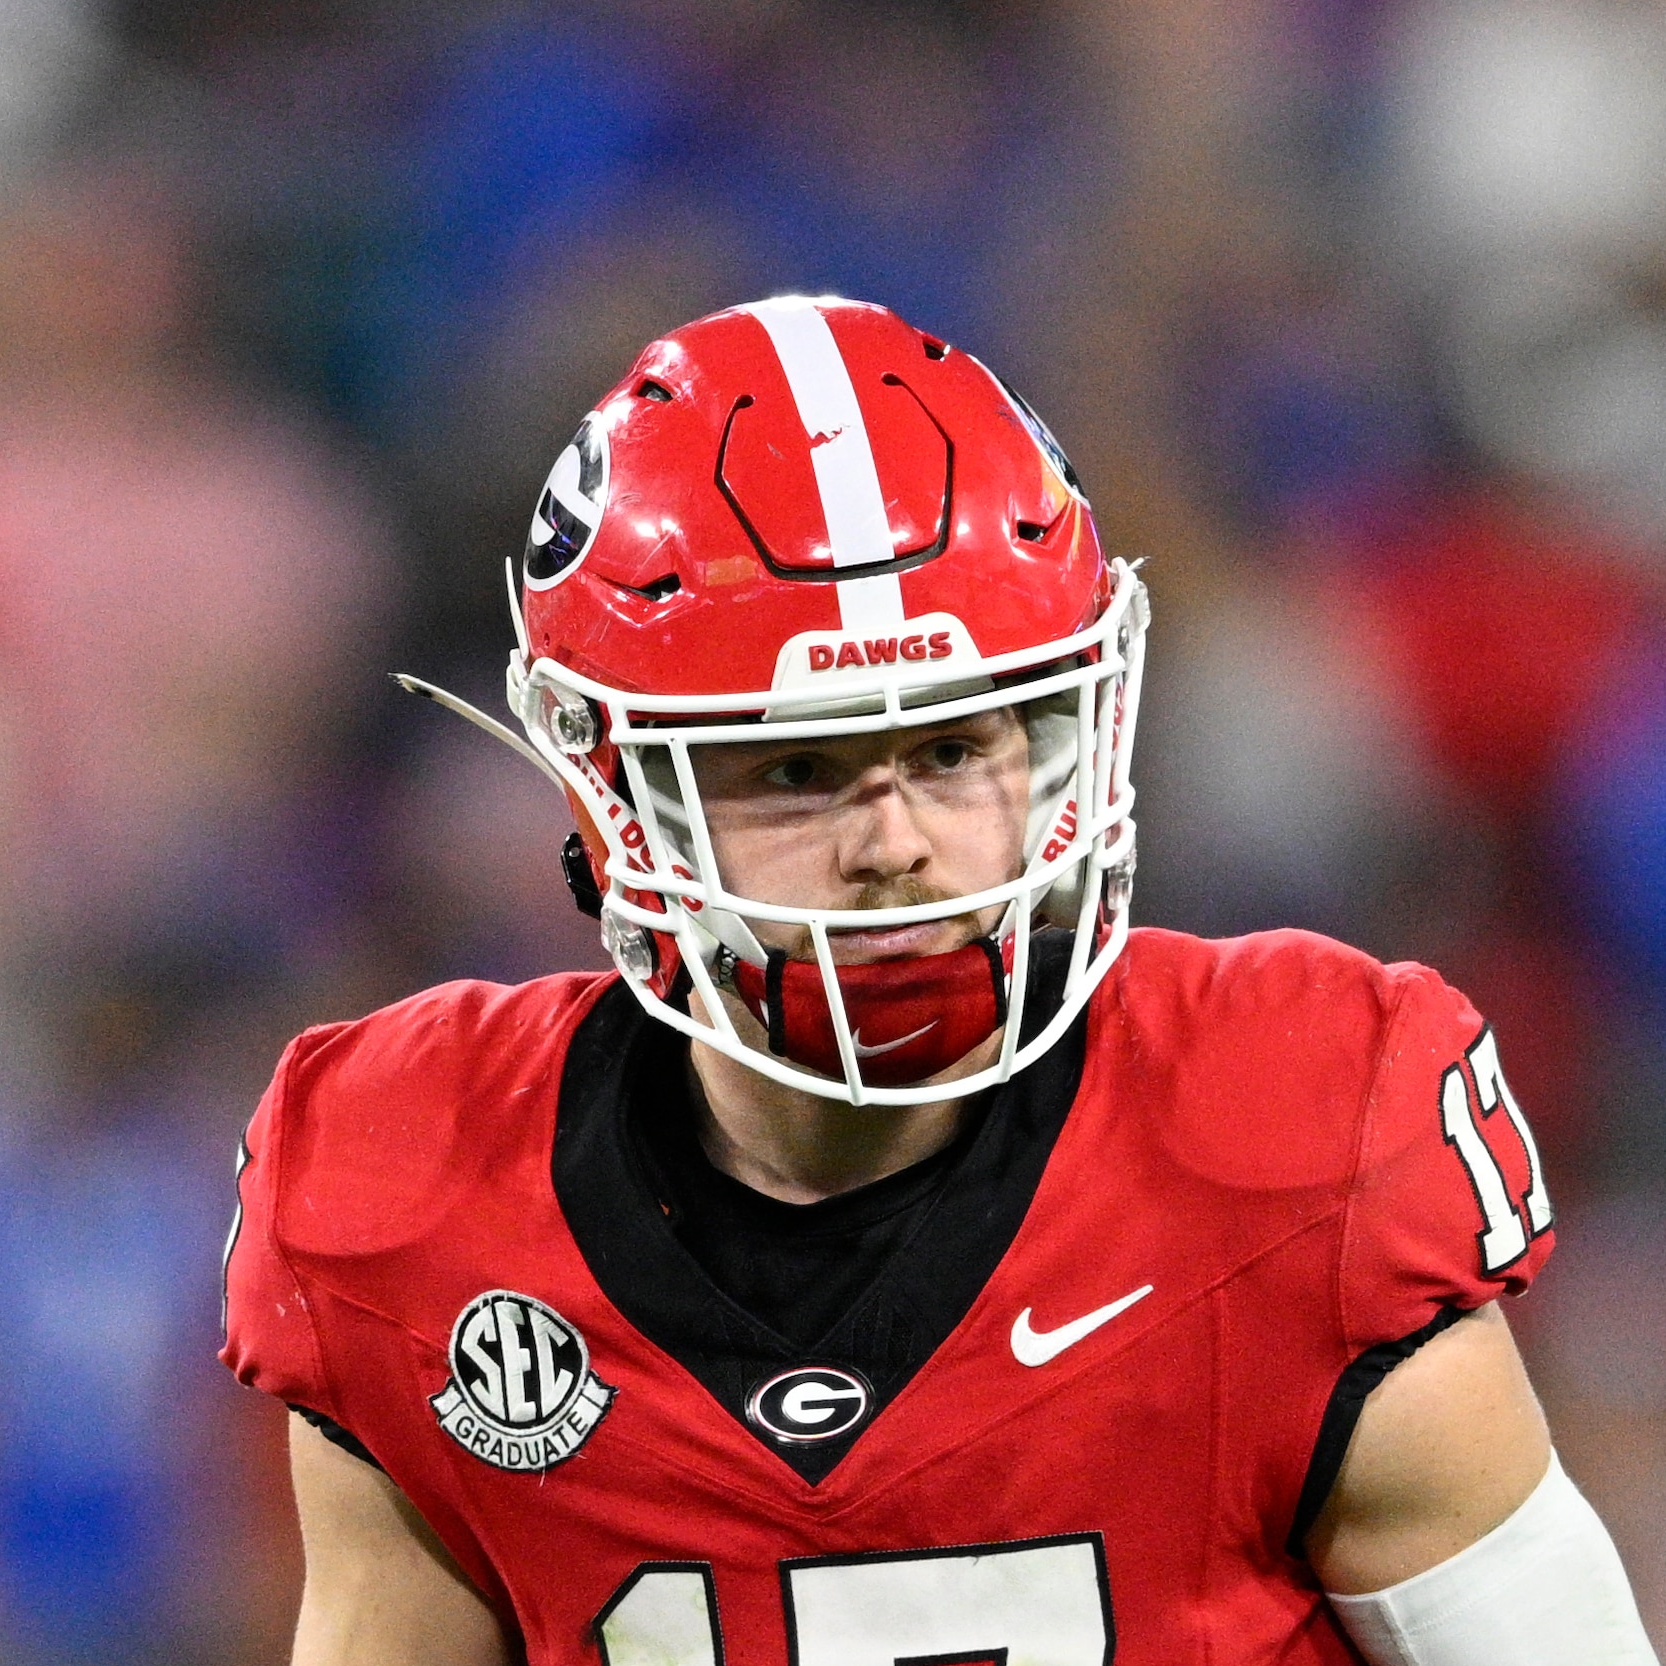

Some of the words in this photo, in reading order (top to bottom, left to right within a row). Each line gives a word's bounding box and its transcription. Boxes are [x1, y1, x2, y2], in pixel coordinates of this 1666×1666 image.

[808, 631, 953, 672] DAWGS
[460, 1300, 575, 1423] SEC
[454, 1411, 589, 1467] GRADUATE
